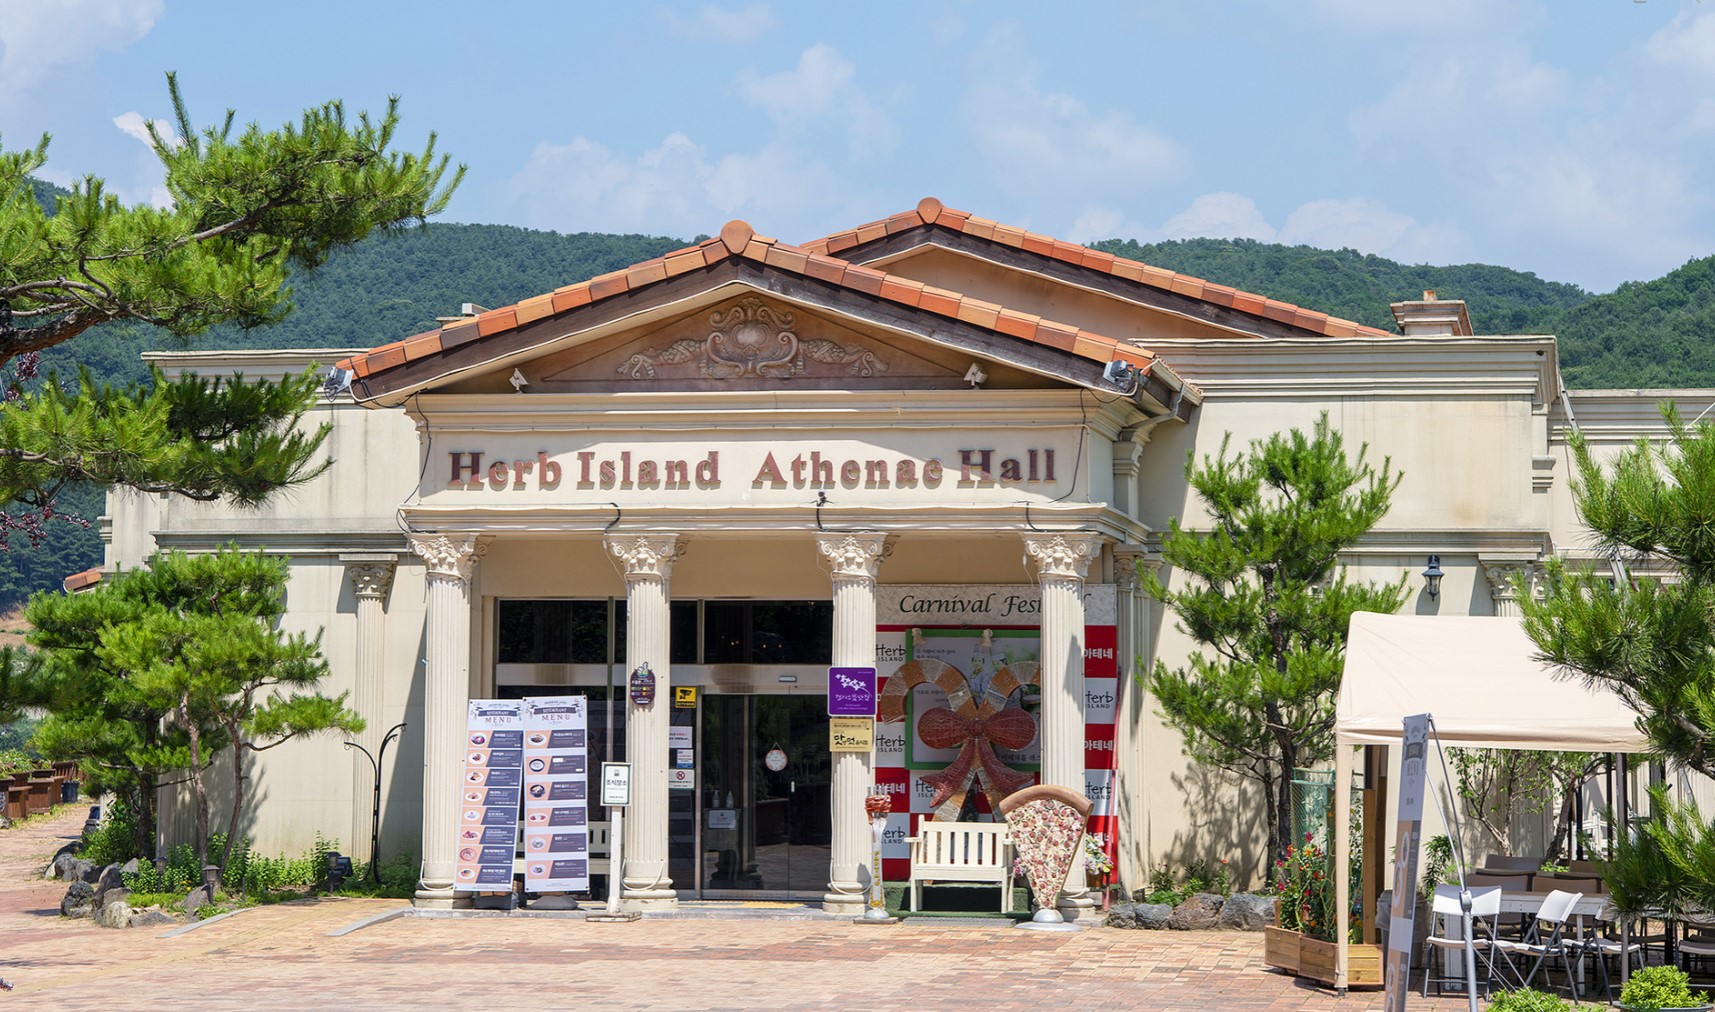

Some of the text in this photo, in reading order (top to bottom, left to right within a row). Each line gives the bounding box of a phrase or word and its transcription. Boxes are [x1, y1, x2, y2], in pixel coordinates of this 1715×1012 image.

[448, 450, 562, 487] Herb
[576, 450, 721, 487] Island
[957, 449, 1056, 484] Hall
[899, 592, 997, 614] Carnival
[484, 716, 512, 724] MENU
[541, 713, 571, 721] MENU
